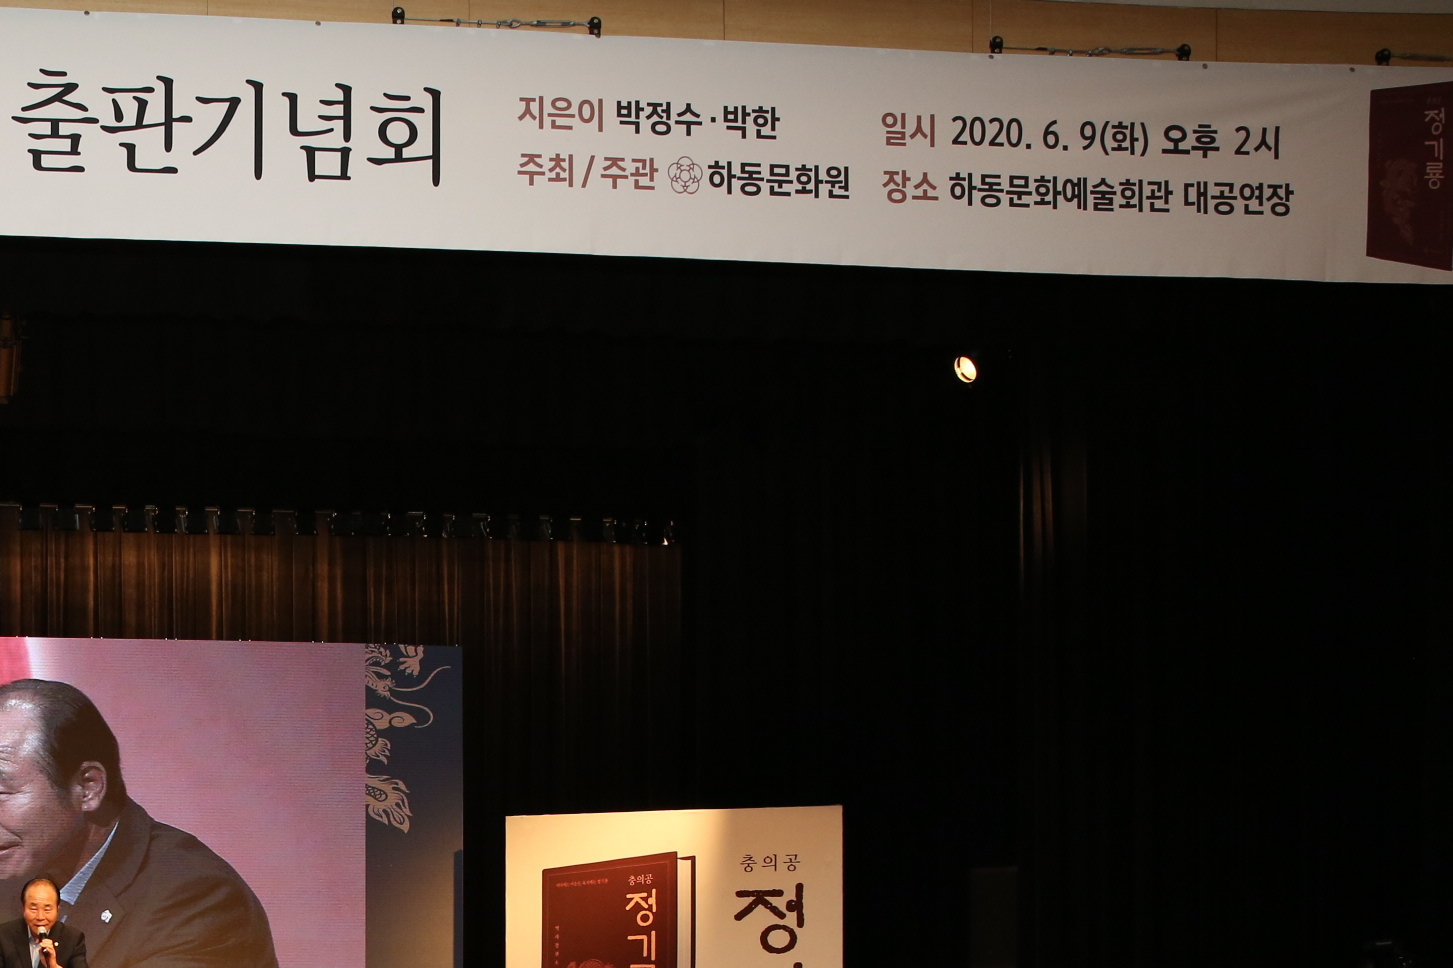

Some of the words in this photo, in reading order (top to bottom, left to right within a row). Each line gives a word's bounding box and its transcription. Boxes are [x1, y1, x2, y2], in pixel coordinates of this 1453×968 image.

[11, 68, 442, 188] 출판기념회
[517, 95, 604, 132] 지은이
[881, 112, 936, 148] 일시
[951, 115, 1032, 150] 2020.
[1042, 119, 1069, 152] 6.
[1079, 120, 1149, 157] 9(화)
[1161, 123, 1221, 159] 오후
[1234, 125, 1281, 160] 2시
[1423, 107, 1445, 190] 정기룡
[707, 160, 850, 200] 하동문화원
[881, 169, 939, 204] 장소
[948, 171, 1174, 214] 하동문화예술회관
[1183, 180, 1295, 217] 대공연장
[628, 873, 654, 886] 충의공
[739, 853, 802, 873] 충의공
